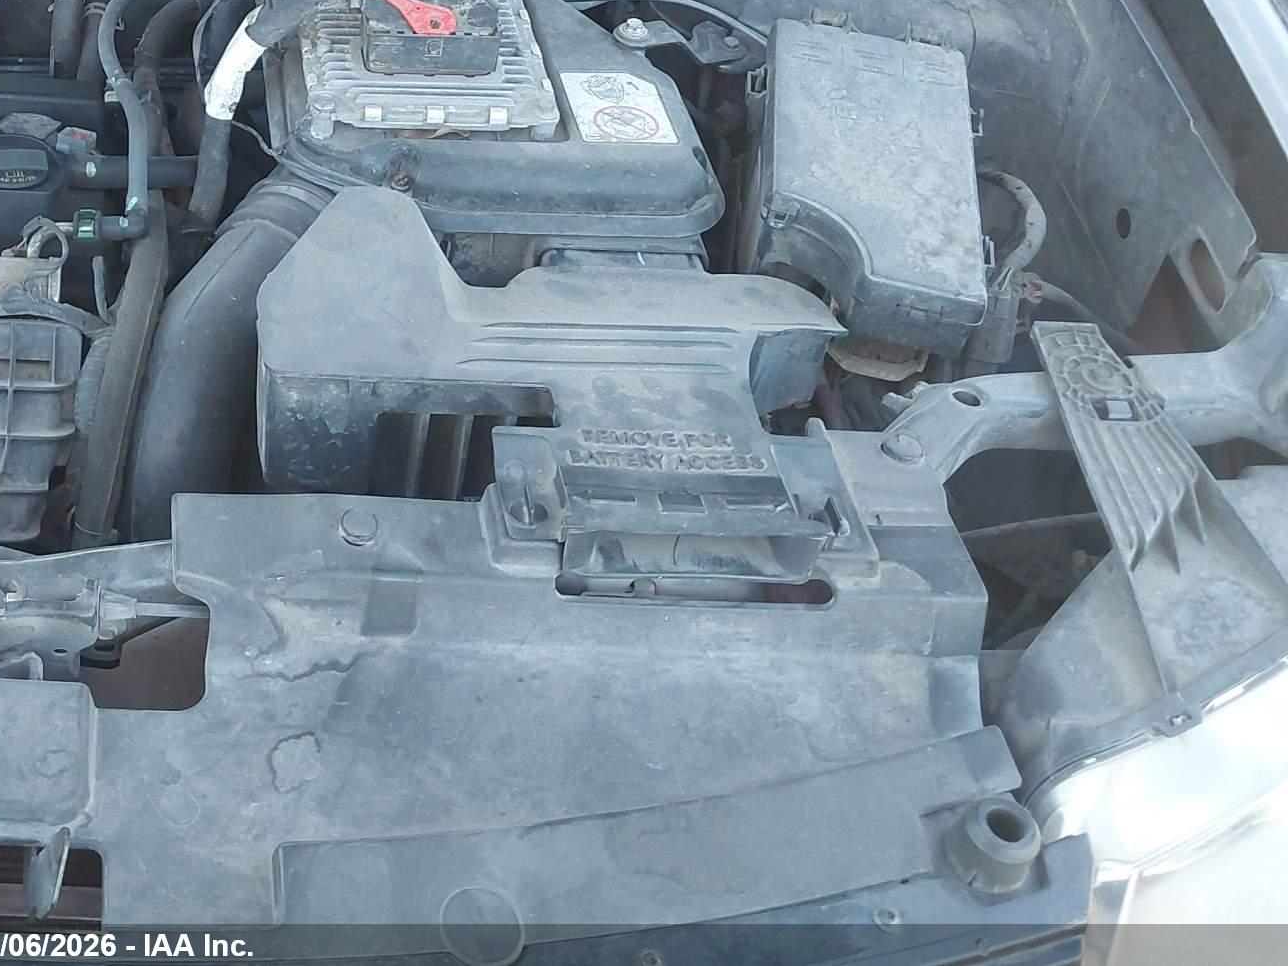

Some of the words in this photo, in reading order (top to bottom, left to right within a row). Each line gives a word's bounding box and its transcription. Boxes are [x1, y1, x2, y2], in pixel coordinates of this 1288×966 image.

[580, 428, 681, 448] REMOVE
[682, 432, 733, 450] FOR
[568, 449, 664, 470] BATTERY
[674, 454, 766, 472] ACCESS
